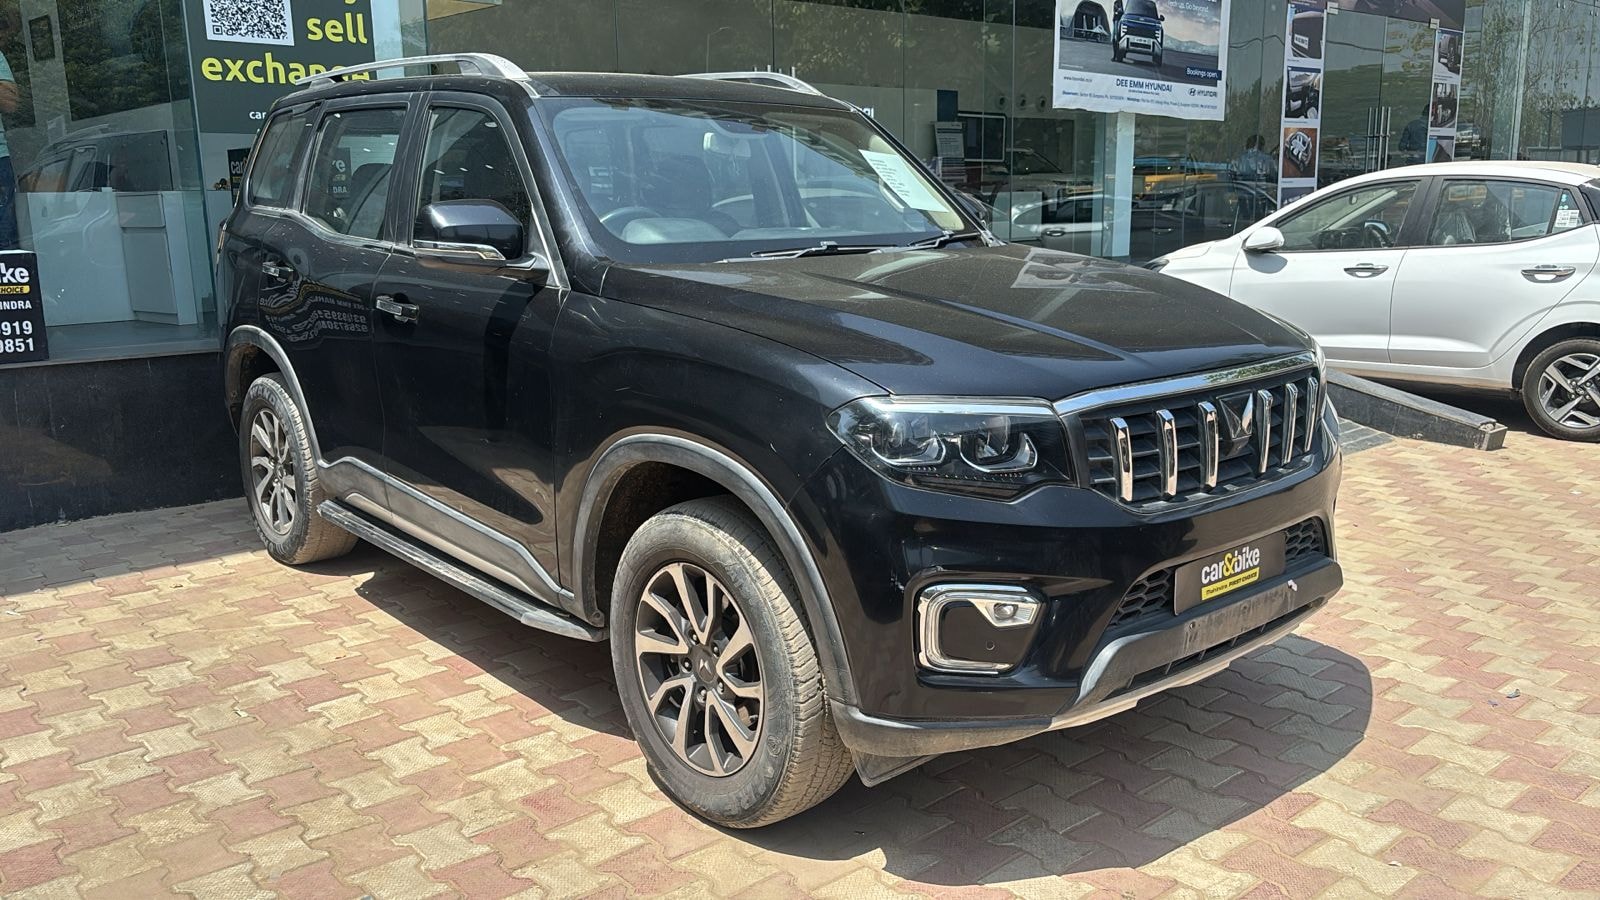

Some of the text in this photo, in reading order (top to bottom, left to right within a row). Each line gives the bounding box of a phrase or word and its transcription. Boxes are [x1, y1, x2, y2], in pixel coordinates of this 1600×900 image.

[306, 12, 368, 44] sell
[201, 52, 370, 84] exchan
[1187, 67, 1206, 78] Bookings
[1116, 78, 1128, 88] DEE
[1129, 79, 1145, 90] EMM
[1145, 81, 1173, 93] HYUNDAI
[1201, 546, 1260, 584] car&bike
[1206, 584, 1228, 595] Mahindra
